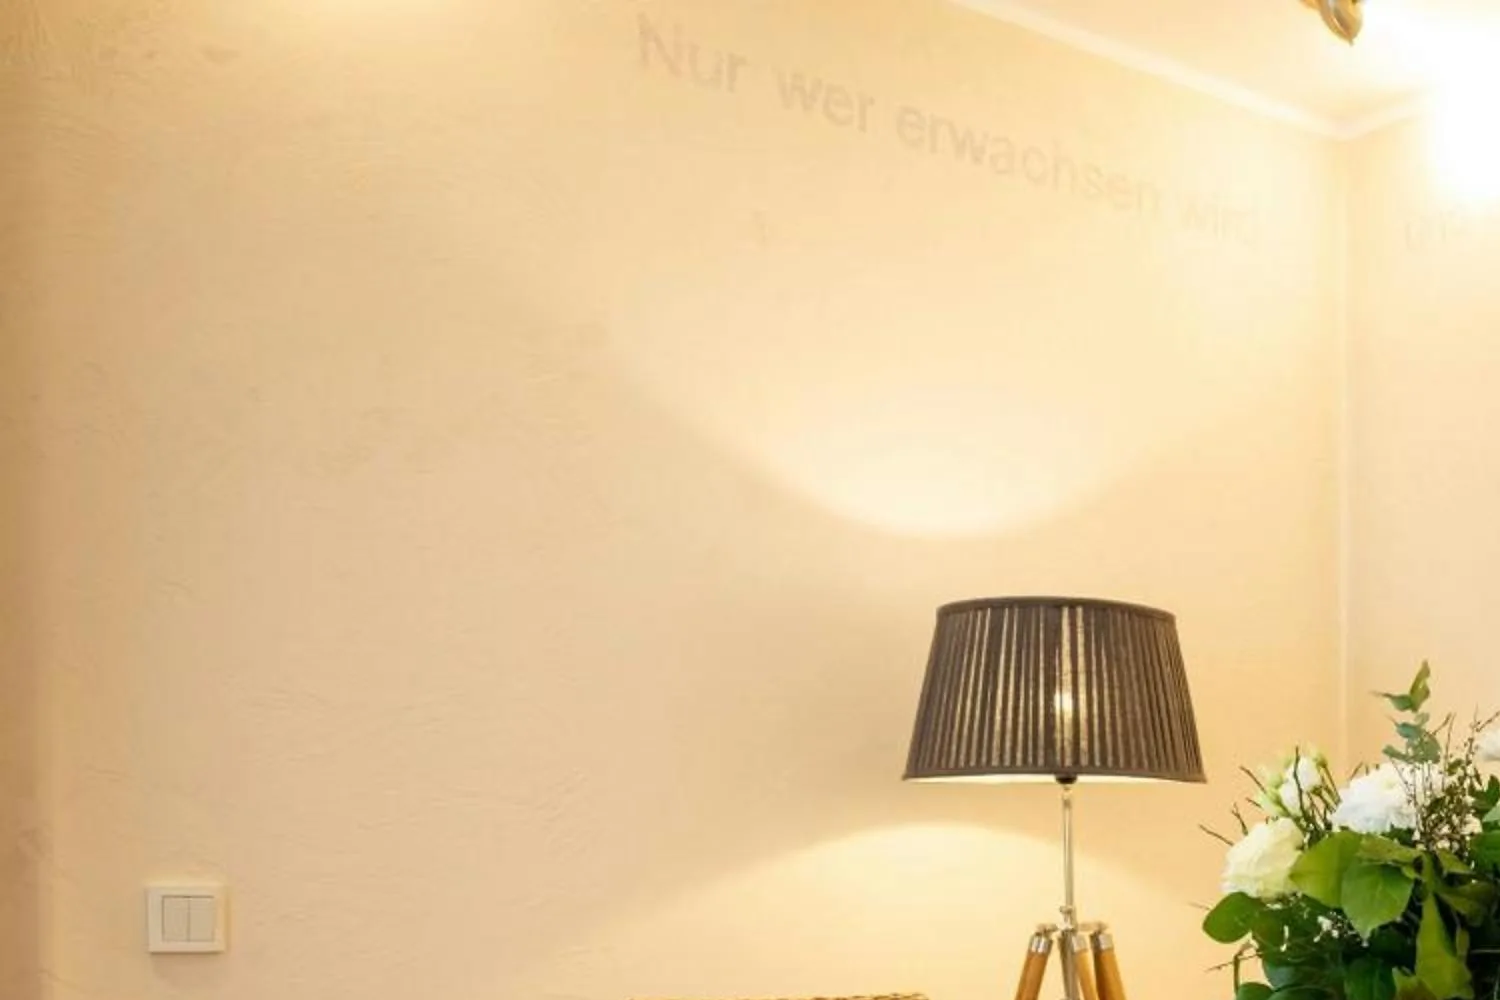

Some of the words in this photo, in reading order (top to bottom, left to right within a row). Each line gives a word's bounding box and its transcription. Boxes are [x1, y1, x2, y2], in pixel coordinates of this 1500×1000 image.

[636, 10, 751, 93] Nur
[770, 64, 876, 134] wer
[895, 103, 1160, 222] erwachsen
